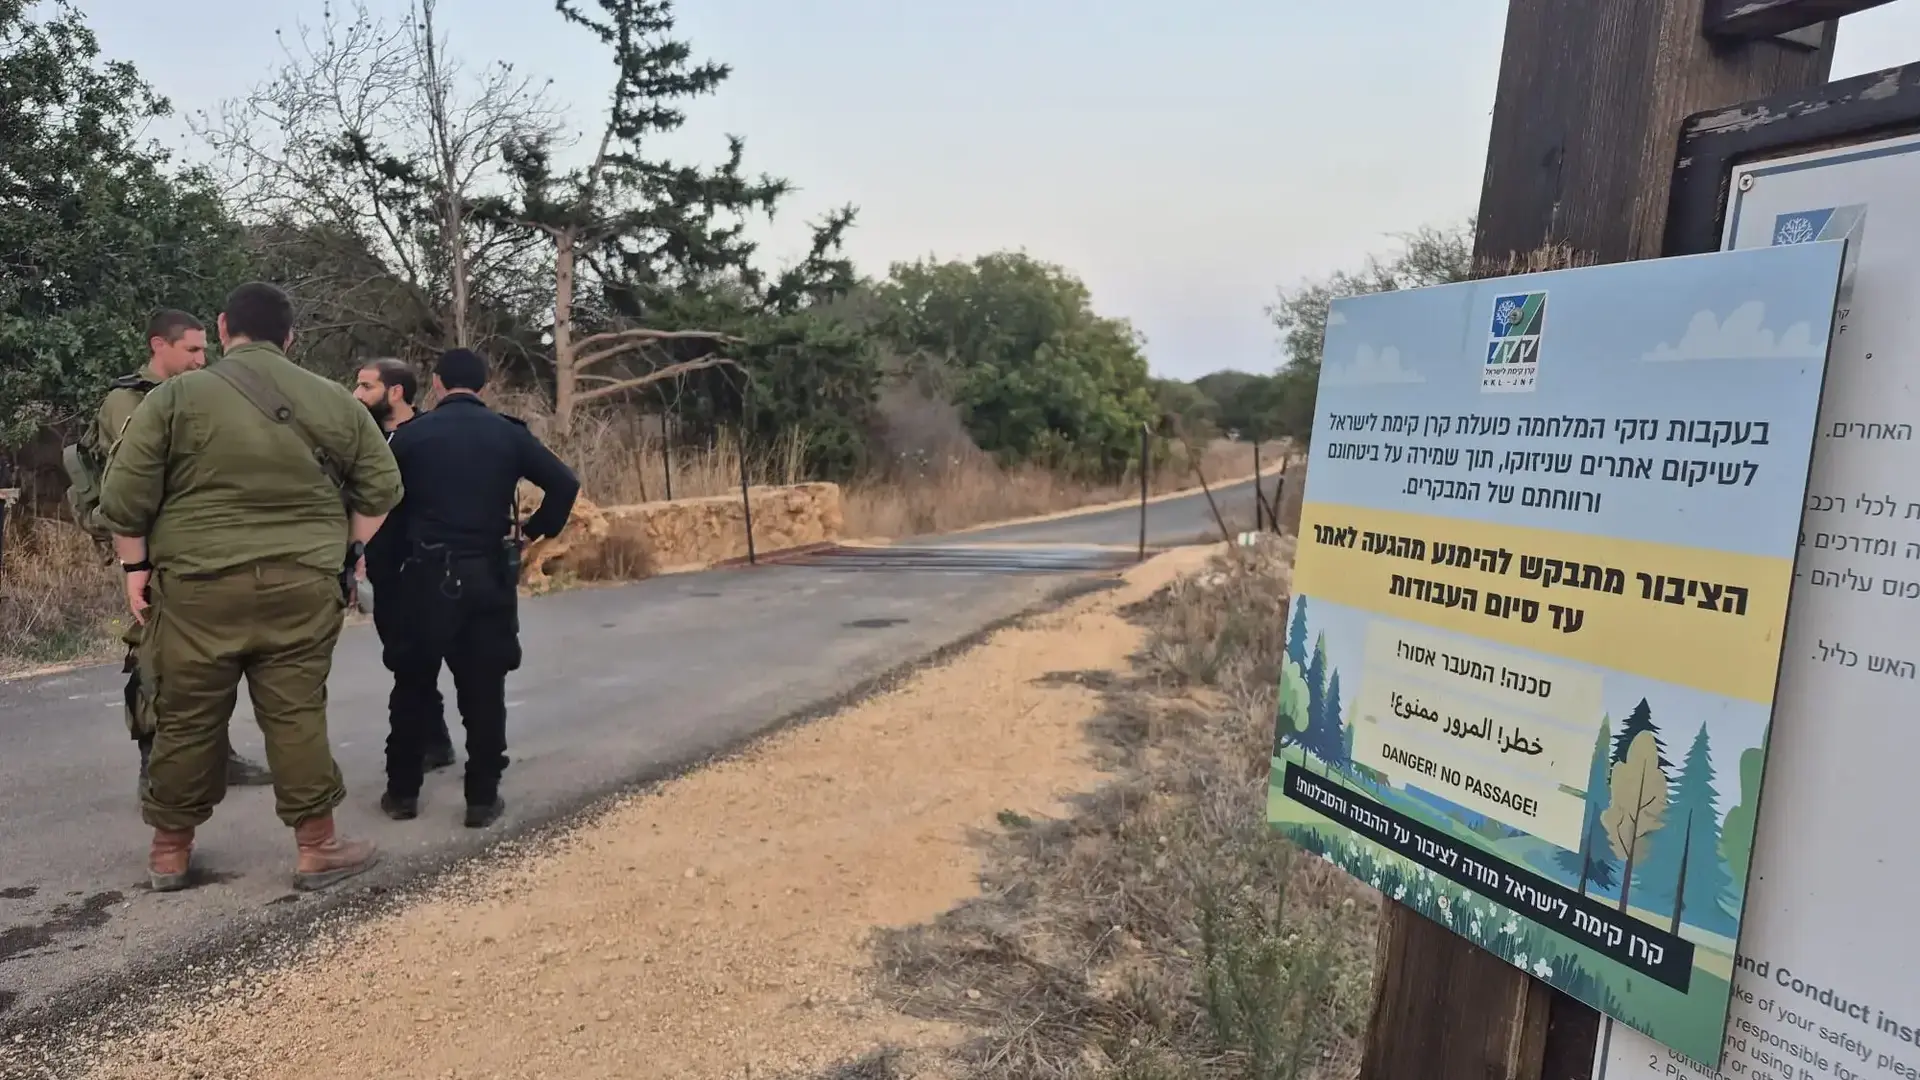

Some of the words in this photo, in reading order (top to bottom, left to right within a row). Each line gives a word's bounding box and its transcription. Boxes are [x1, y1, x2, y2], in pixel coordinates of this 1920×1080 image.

[1329, 412, 1378, 432] לישראל
[1381, 414, 1419, 437] קימת
[1423, 415, 1450, 437] קרן
[1455, 413, 1511, 436] פועלת
[1517, 414, 1605, 439] המלחמה
[1614, 418, 1659, 444] נזקי
[1666, 419, 1769, 448] בעקבות
[1825, 422, 1913, 441] האחרים.
[1327, 442, 1380, 461] ביטחונם
[1384, 443, 1403, 463] על
[1407, 445, 1459, 466] שמירה
[1465, 448, 1494, 472] תוך
[1498, 450, 1573, 474] שניזוקו,
[1580, 454, 1653, 479] אתרים
[1661, 459, 1759, 487] לשיקום
[1402, 477, 1481, 501] המבקרים.
[1487, 481, 1515, 504] של
[1521, 487, 1601, 513] ורווחתם
[1855, 493, 1897, 517] לכלי
[1313, 523, 1358, 549] לאתר
[1361, 531, 1426, 561] מהגעה
[1814, 532, 1897, 557] ומדרכים
[1431, 541, 1513, 575] להימנע
[1519, 555, 1626, 595] מתבקש
[1811, 568, 1873, 592] עליהם
[1388, 573, 1478, 612] העבודות
[1636, 572, 1749, 616] הציבור
[1484, 591, 1539, 624] סיום
[1548, 603, 1585, 633] עד
[1397, 640, 1436, 666] אסור!
[1811, 639, 1858, 667] כליל.
[1441, 653, 1495, 683] המעבר
[1867, 655, 1917, 679] האש
[1500, 667, 1552, 698] סכנה!
[1390, 691, 1440, 723] ممنوع!
[1443, 717, 1493, 741] المرور
[1497, 726, 1544, 756] خطر!
[1382, 743, 1437, 778] DANGER!
[1440, 766, 1462, 787] NO
[1464, 775, 1539, 818] PASSAGE!
[1296, 775, 1348, 815] והסבלנות!
[1349, 803, 1390, 836] ההבנה
[1393, 822, 1411, 844] על
[1414, 833, 1459, 867] לציבור
[1461, 857, 1500, 888] מודה
[1503, 874, 1569, 919] לישראל
[1572, 908, 1623, 947] קימת
[1628, 934, 1664, 966] קרן
[1775, 967, 1871, 1025] Conduct
[1732, 984, 1754, 1004] ke
[1758, 998, 1776, 1014] of
[1777, 1006, 1815, 1032] your
[1819, 1025, 1873, 1063] safety
[1877, 1054, 1920, 1080] plea
[1735, 1016, 1829, 1072] responsible
[1649, 1054, 1661, 1072] 2.
[1727, 1034, 1747, 1053] nd
[1751, 1047, 1794, 1080] using
[1732, 1060, 1748, 1075] or
